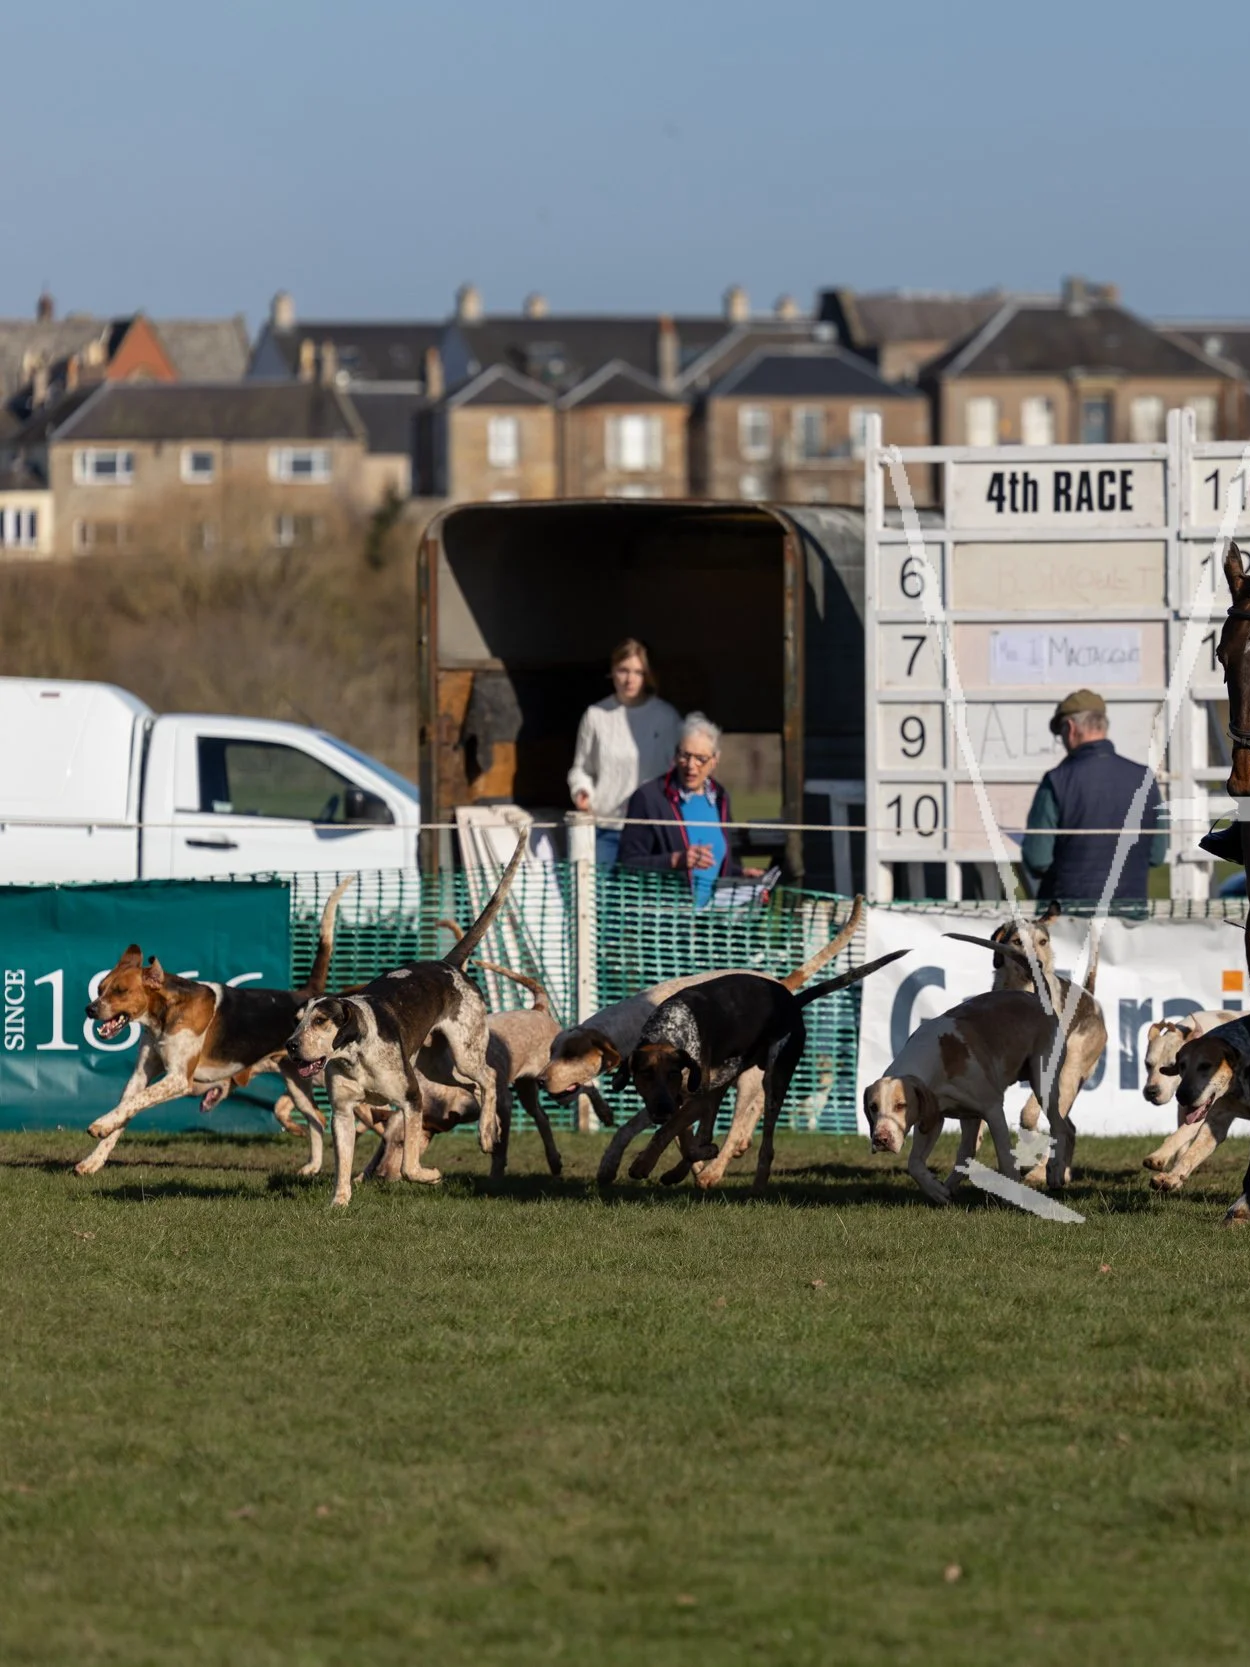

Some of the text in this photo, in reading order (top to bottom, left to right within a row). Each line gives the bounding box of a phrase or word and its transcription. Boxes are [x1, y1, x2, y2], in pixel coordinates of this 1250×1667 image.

[986, 469, 1133, 513] 4th RACE
[900, 556, 924, 599] 6
[902, 635, 927, 677] 7
[900, 715, 926, 759] 9
[886, 794, 939, 837] 10
[4, 969, 25, 1051] SINCE
